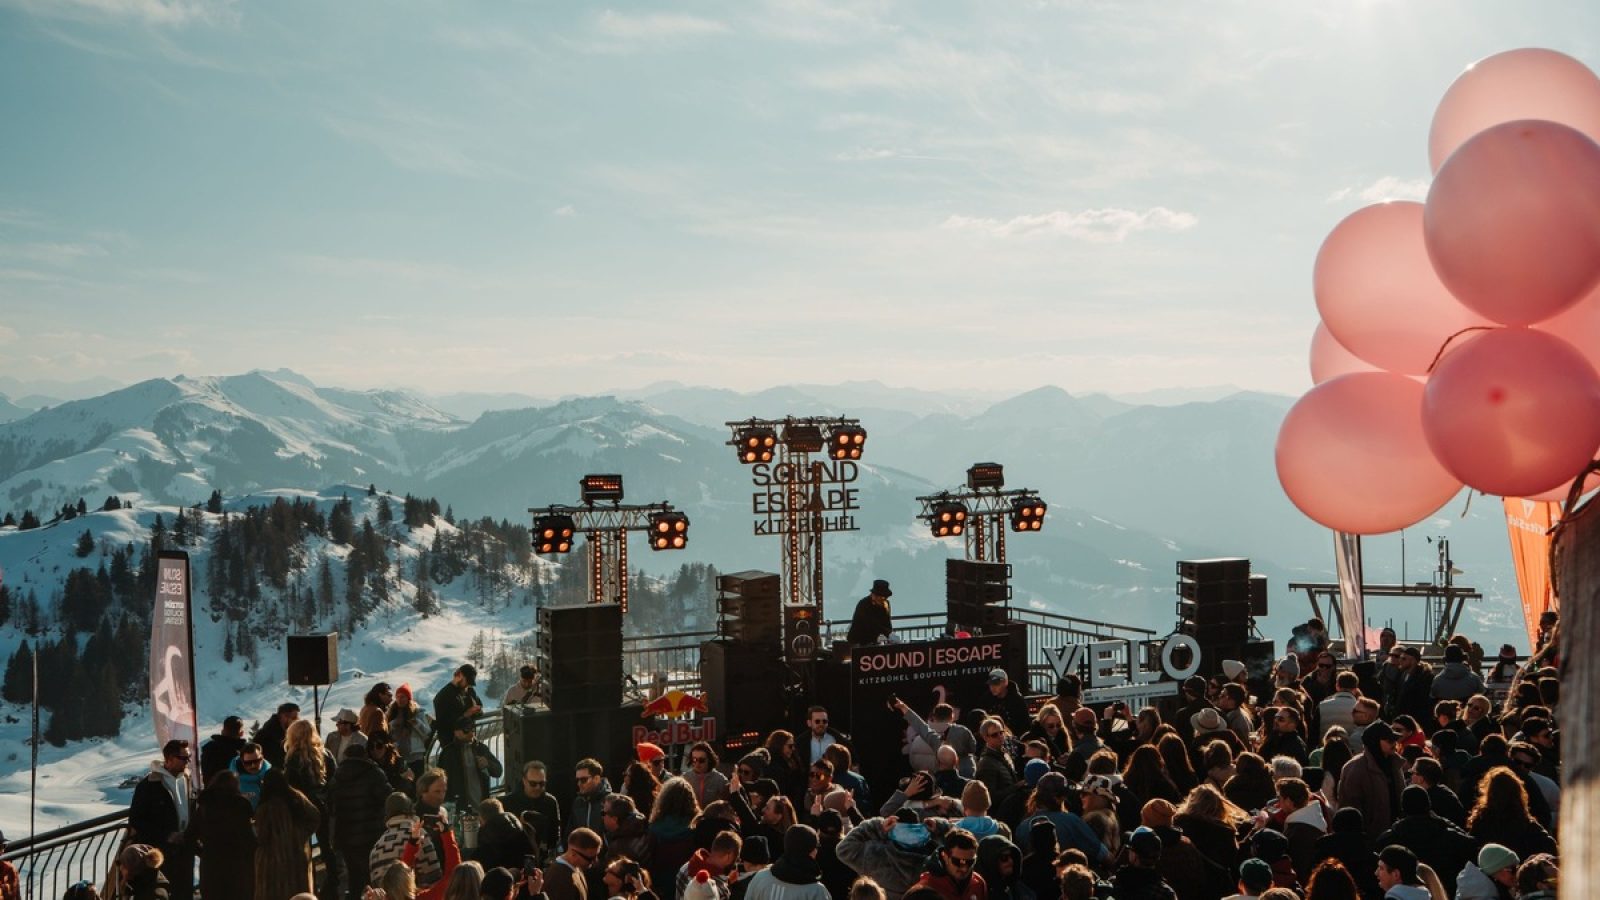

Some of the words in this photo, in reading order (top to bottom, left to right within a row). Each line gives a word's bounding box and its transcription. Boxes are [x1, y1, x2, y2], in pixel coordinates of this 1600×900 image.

[752, 461, 859, 486] SOUND
[752, 489, 860, 514] ESCAPE
[754, 515, 860, 536] KITZBHEL
[859, 651, 925, 672] SOUND
[936, 644, 1002, 665] ESCAPE
[1042, 634, 1202, 688] VELO
[913, 669, 958, 680] BOUTIQUE
[632, 720, 673, 748] Red
[676, 717, 717, 745] Bull
